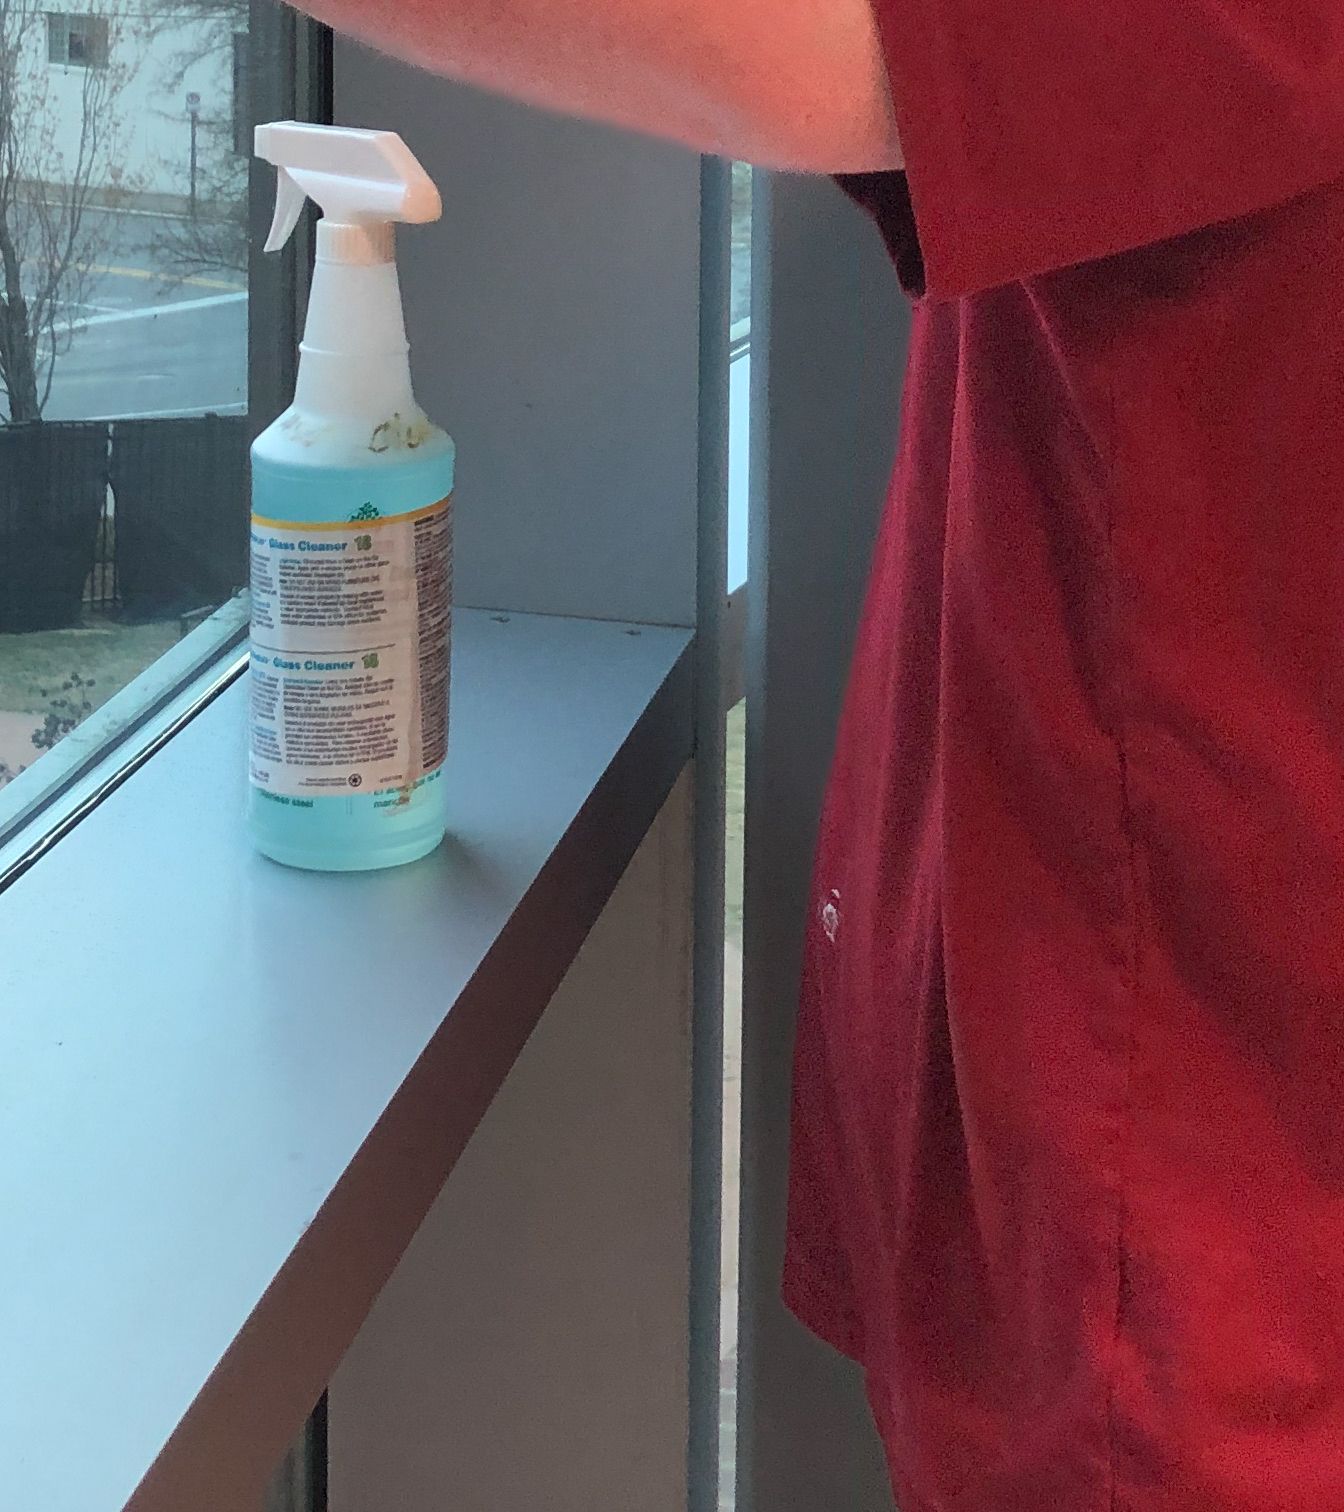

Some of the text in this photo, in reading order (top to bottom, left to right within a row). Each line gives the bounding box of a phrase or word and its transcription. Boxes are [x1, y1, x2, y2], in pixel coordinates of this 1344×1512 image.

[269, 538, 295, 550] Glass
[298, 541, 347, 552] Cleaner
[273, 656, 301, 669] Glass
[304, 661, 355, 671] Cleaner
